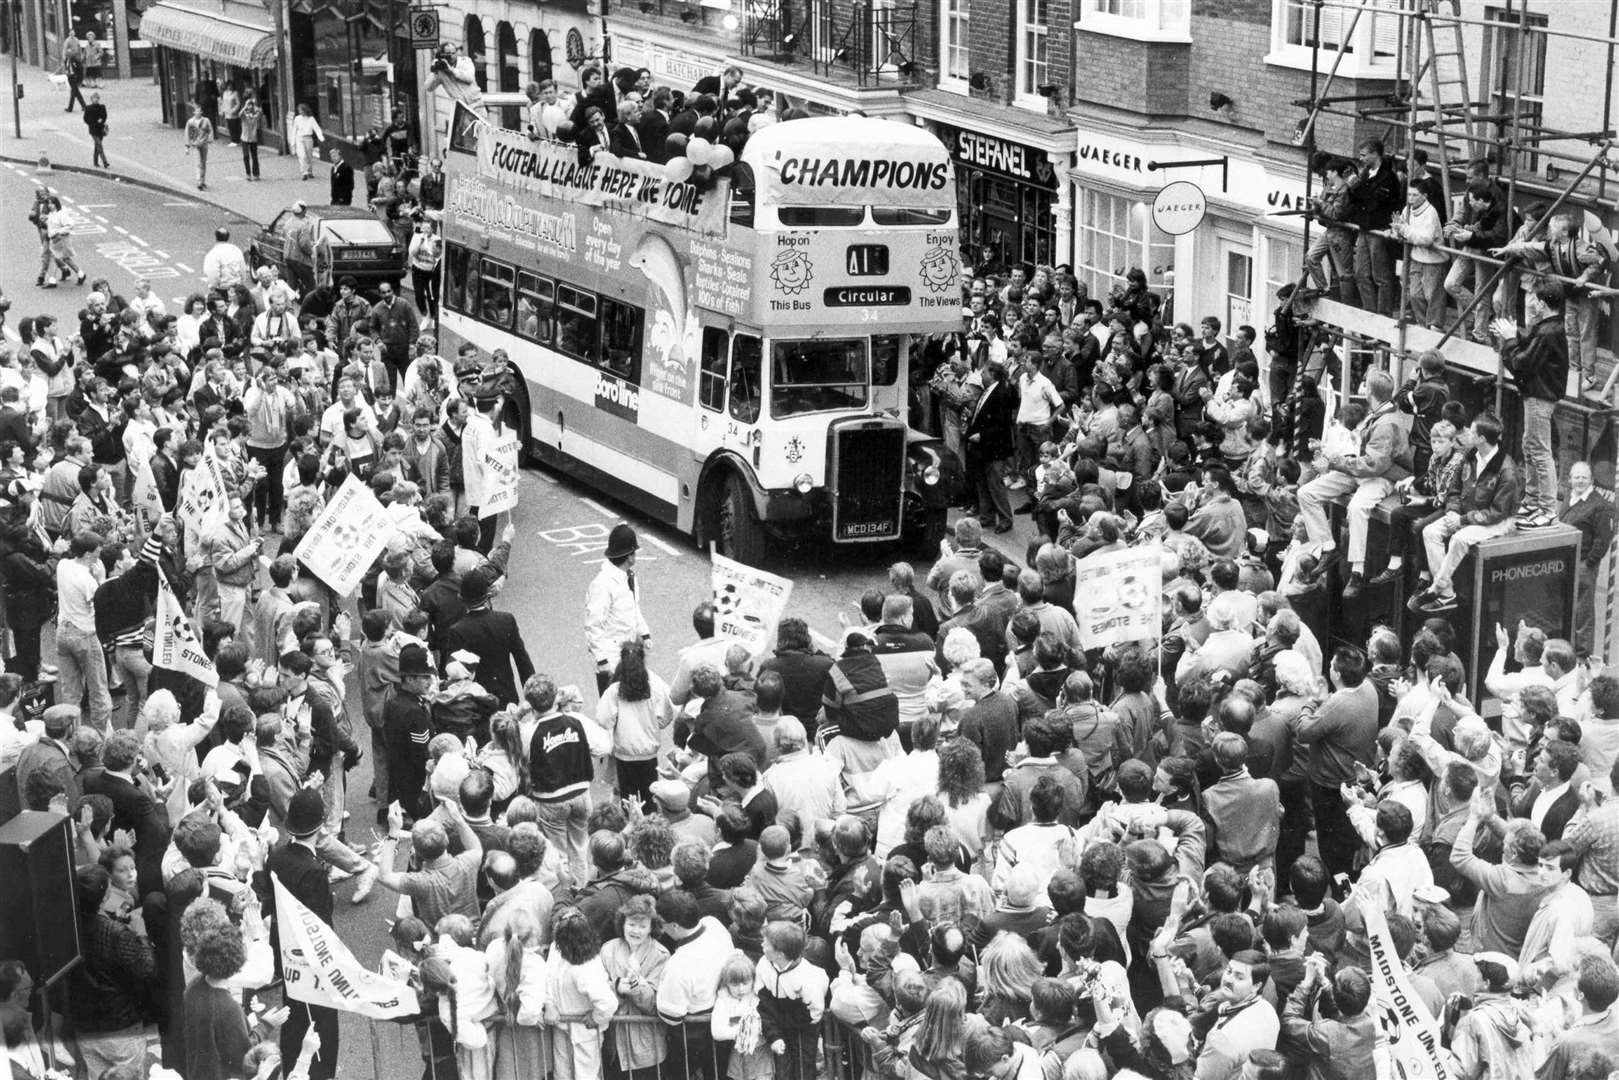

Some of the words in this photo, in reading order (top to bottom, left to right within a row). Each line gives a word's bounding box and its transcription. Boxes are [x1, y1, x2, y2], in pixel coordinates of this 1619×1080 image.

[959, 131, 1031, 179] STEFANEL
[1080, 145, 1142, 173] JAEGER
[601, 167, 639, 198] HERE
[637, 175, 662, 203] WE
[1157, 202, 1201, 213] JAEGER
[1268, 190, 1314, 211] JAE
[593, 216, 613, 235] Open
[585, 235, 607, 255] every
[607, 237, 622, 258] day
[777, 235, 797, 247] Hop
[797, 237, 810, 246] on
[926, 234, 954, 247] Enjoy
[584, 250, 593, 262] of
[594, 251, 605, 266] the
[605, 257, 621, 272] year
[727, 266, 747, 284] Seals
[770, 300, 790, 310] This
[793, 300, 811, 310] Bus
[838, 290, 895, 303] Circular
[919, 297, 936, 307] The
[936, 297, 961, 307] Views
[861, 309, 878, 321] 34
[727, 422, 738, 436] 34
[1491, 560, 1564, 582] PHONECARD
[181, 648, 213, 671] STONES
[1369, 934, 1420, 1027] MAIDSTONE
[1416, 1029, 1447, 1080] UNITED
